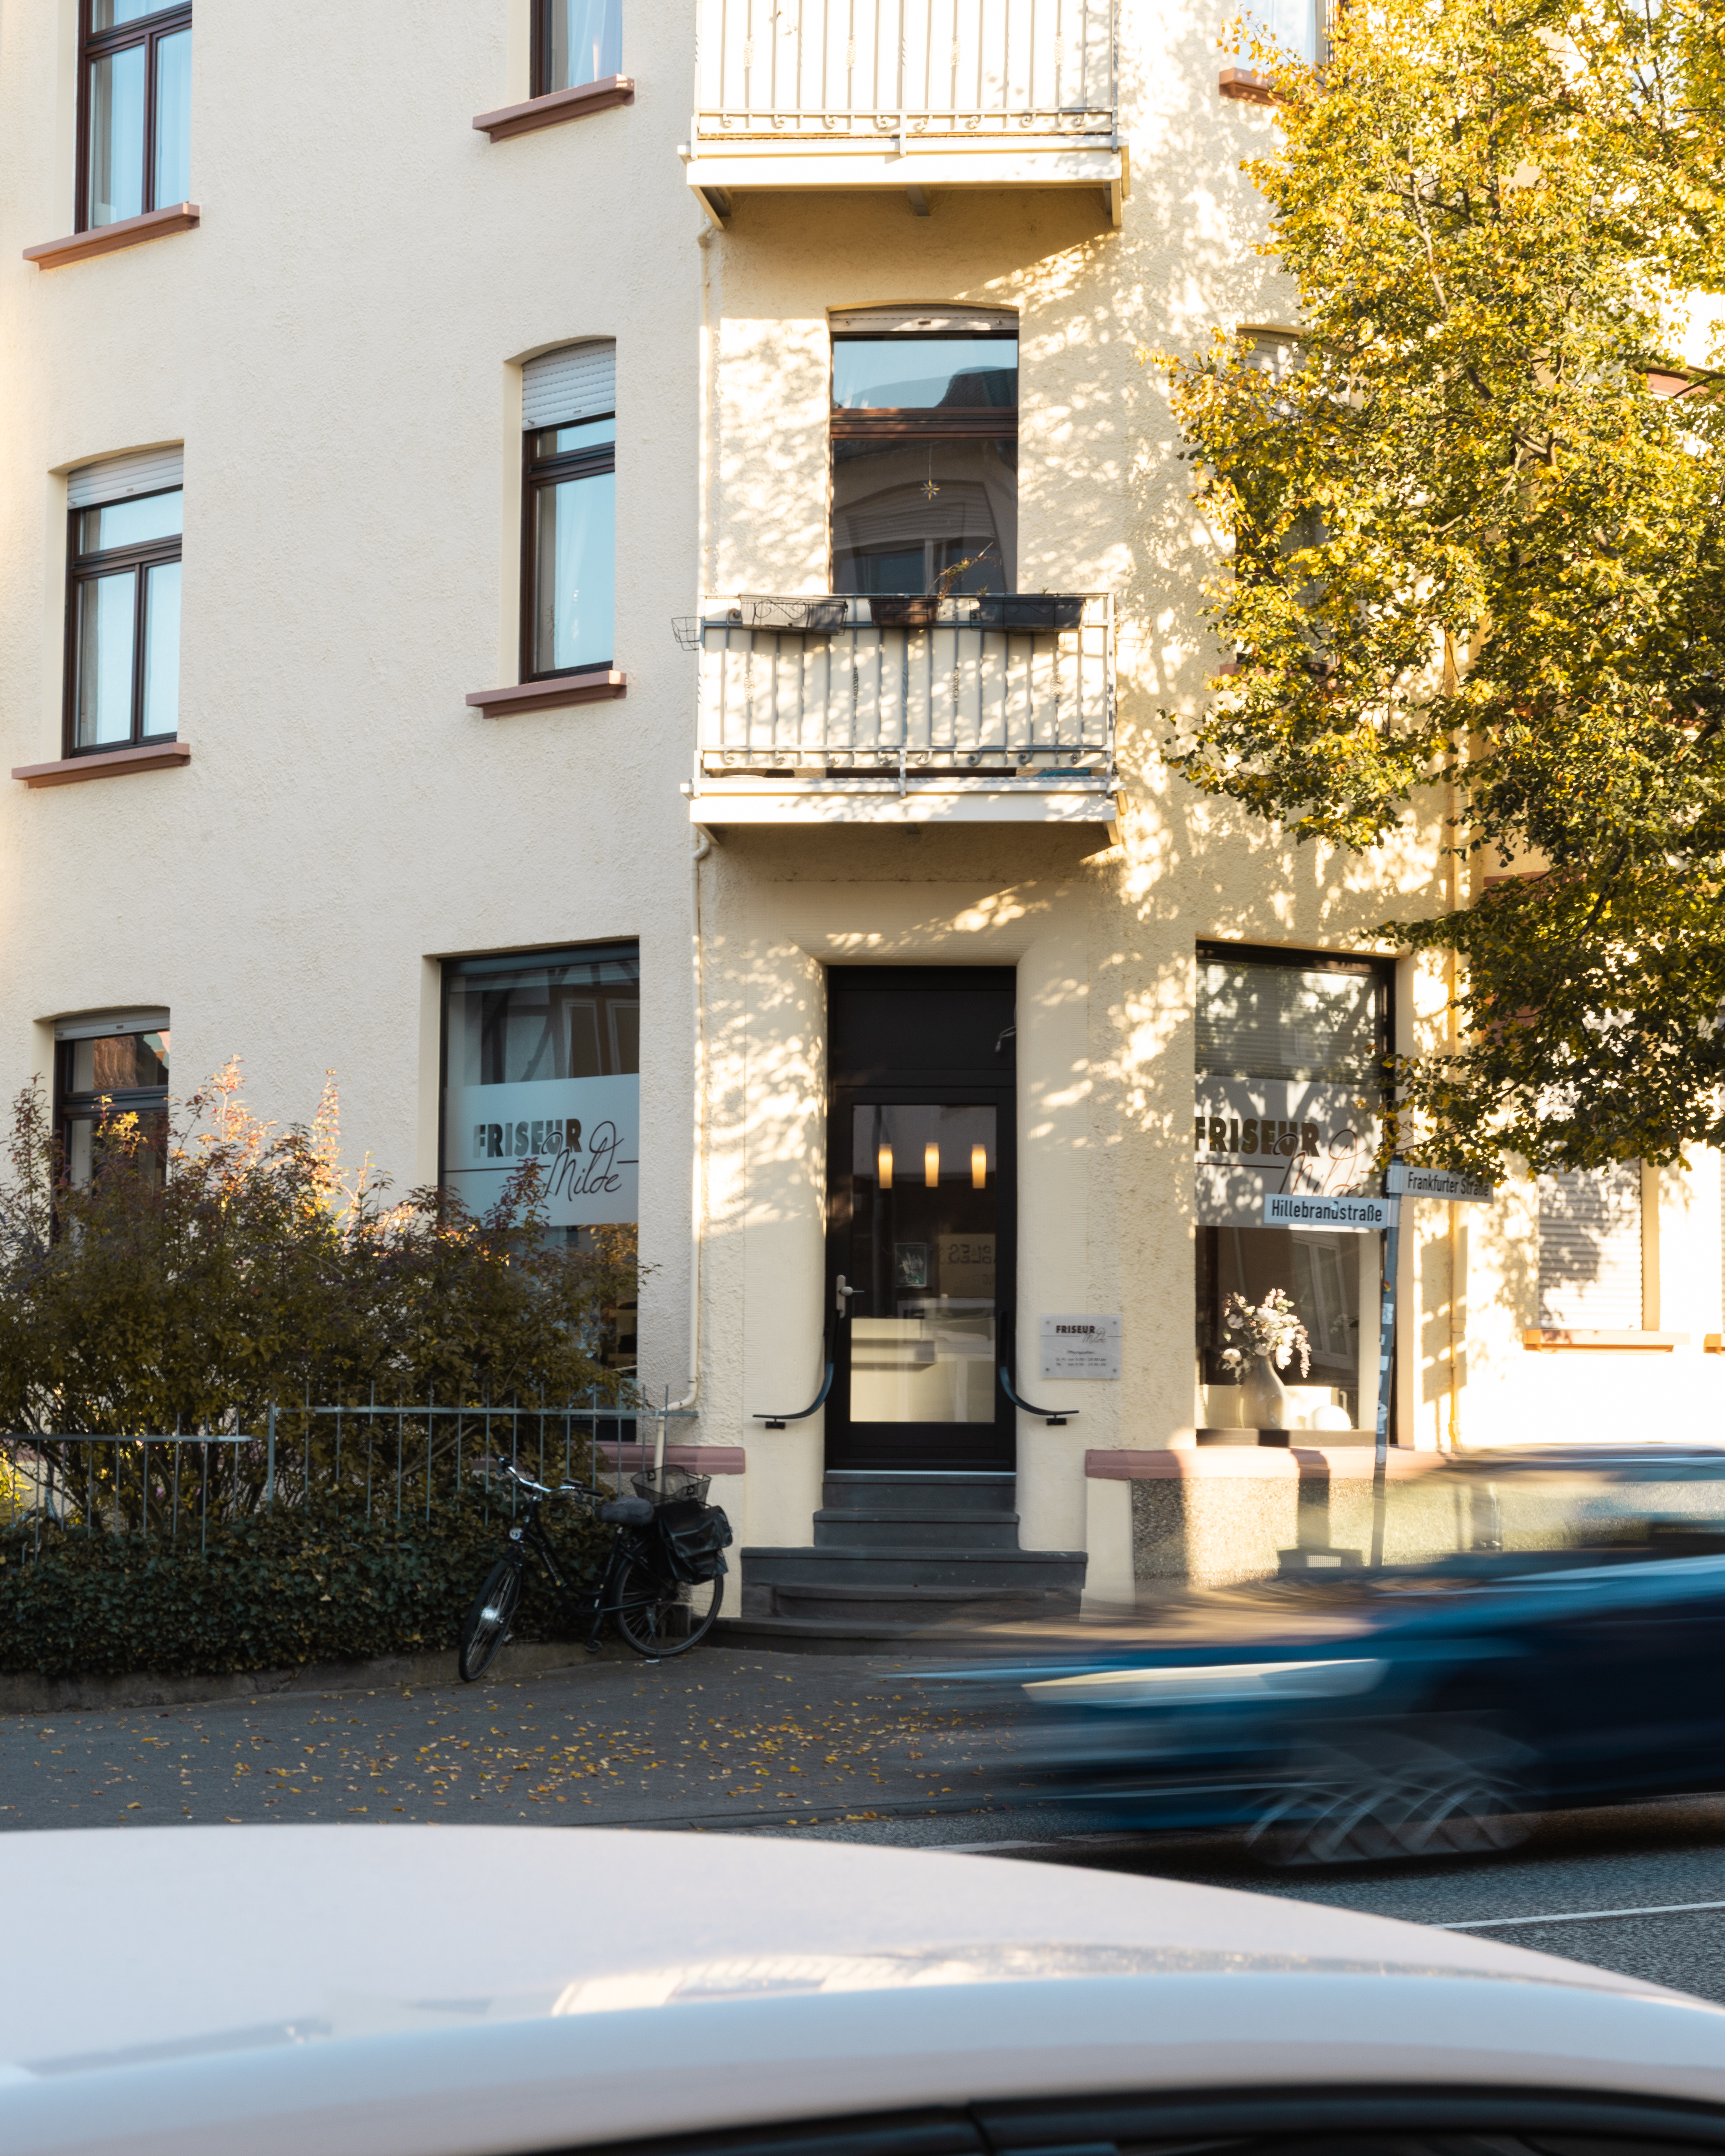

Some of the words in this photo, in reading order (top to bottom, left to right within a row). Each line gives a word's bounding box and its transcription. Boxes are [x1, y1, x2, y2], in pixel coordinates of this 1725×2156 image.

[473, 1119, 582, 1158] FRISEUR
[1195, 1116, 1320, 1157] FRISEUR
[1407, 1171, 1459, 1193] Frankfurter
[1271, 1199, 1382, 1222] Hillebrandstraße
[1056, 1325, 1095, 1334] FRISEUR
